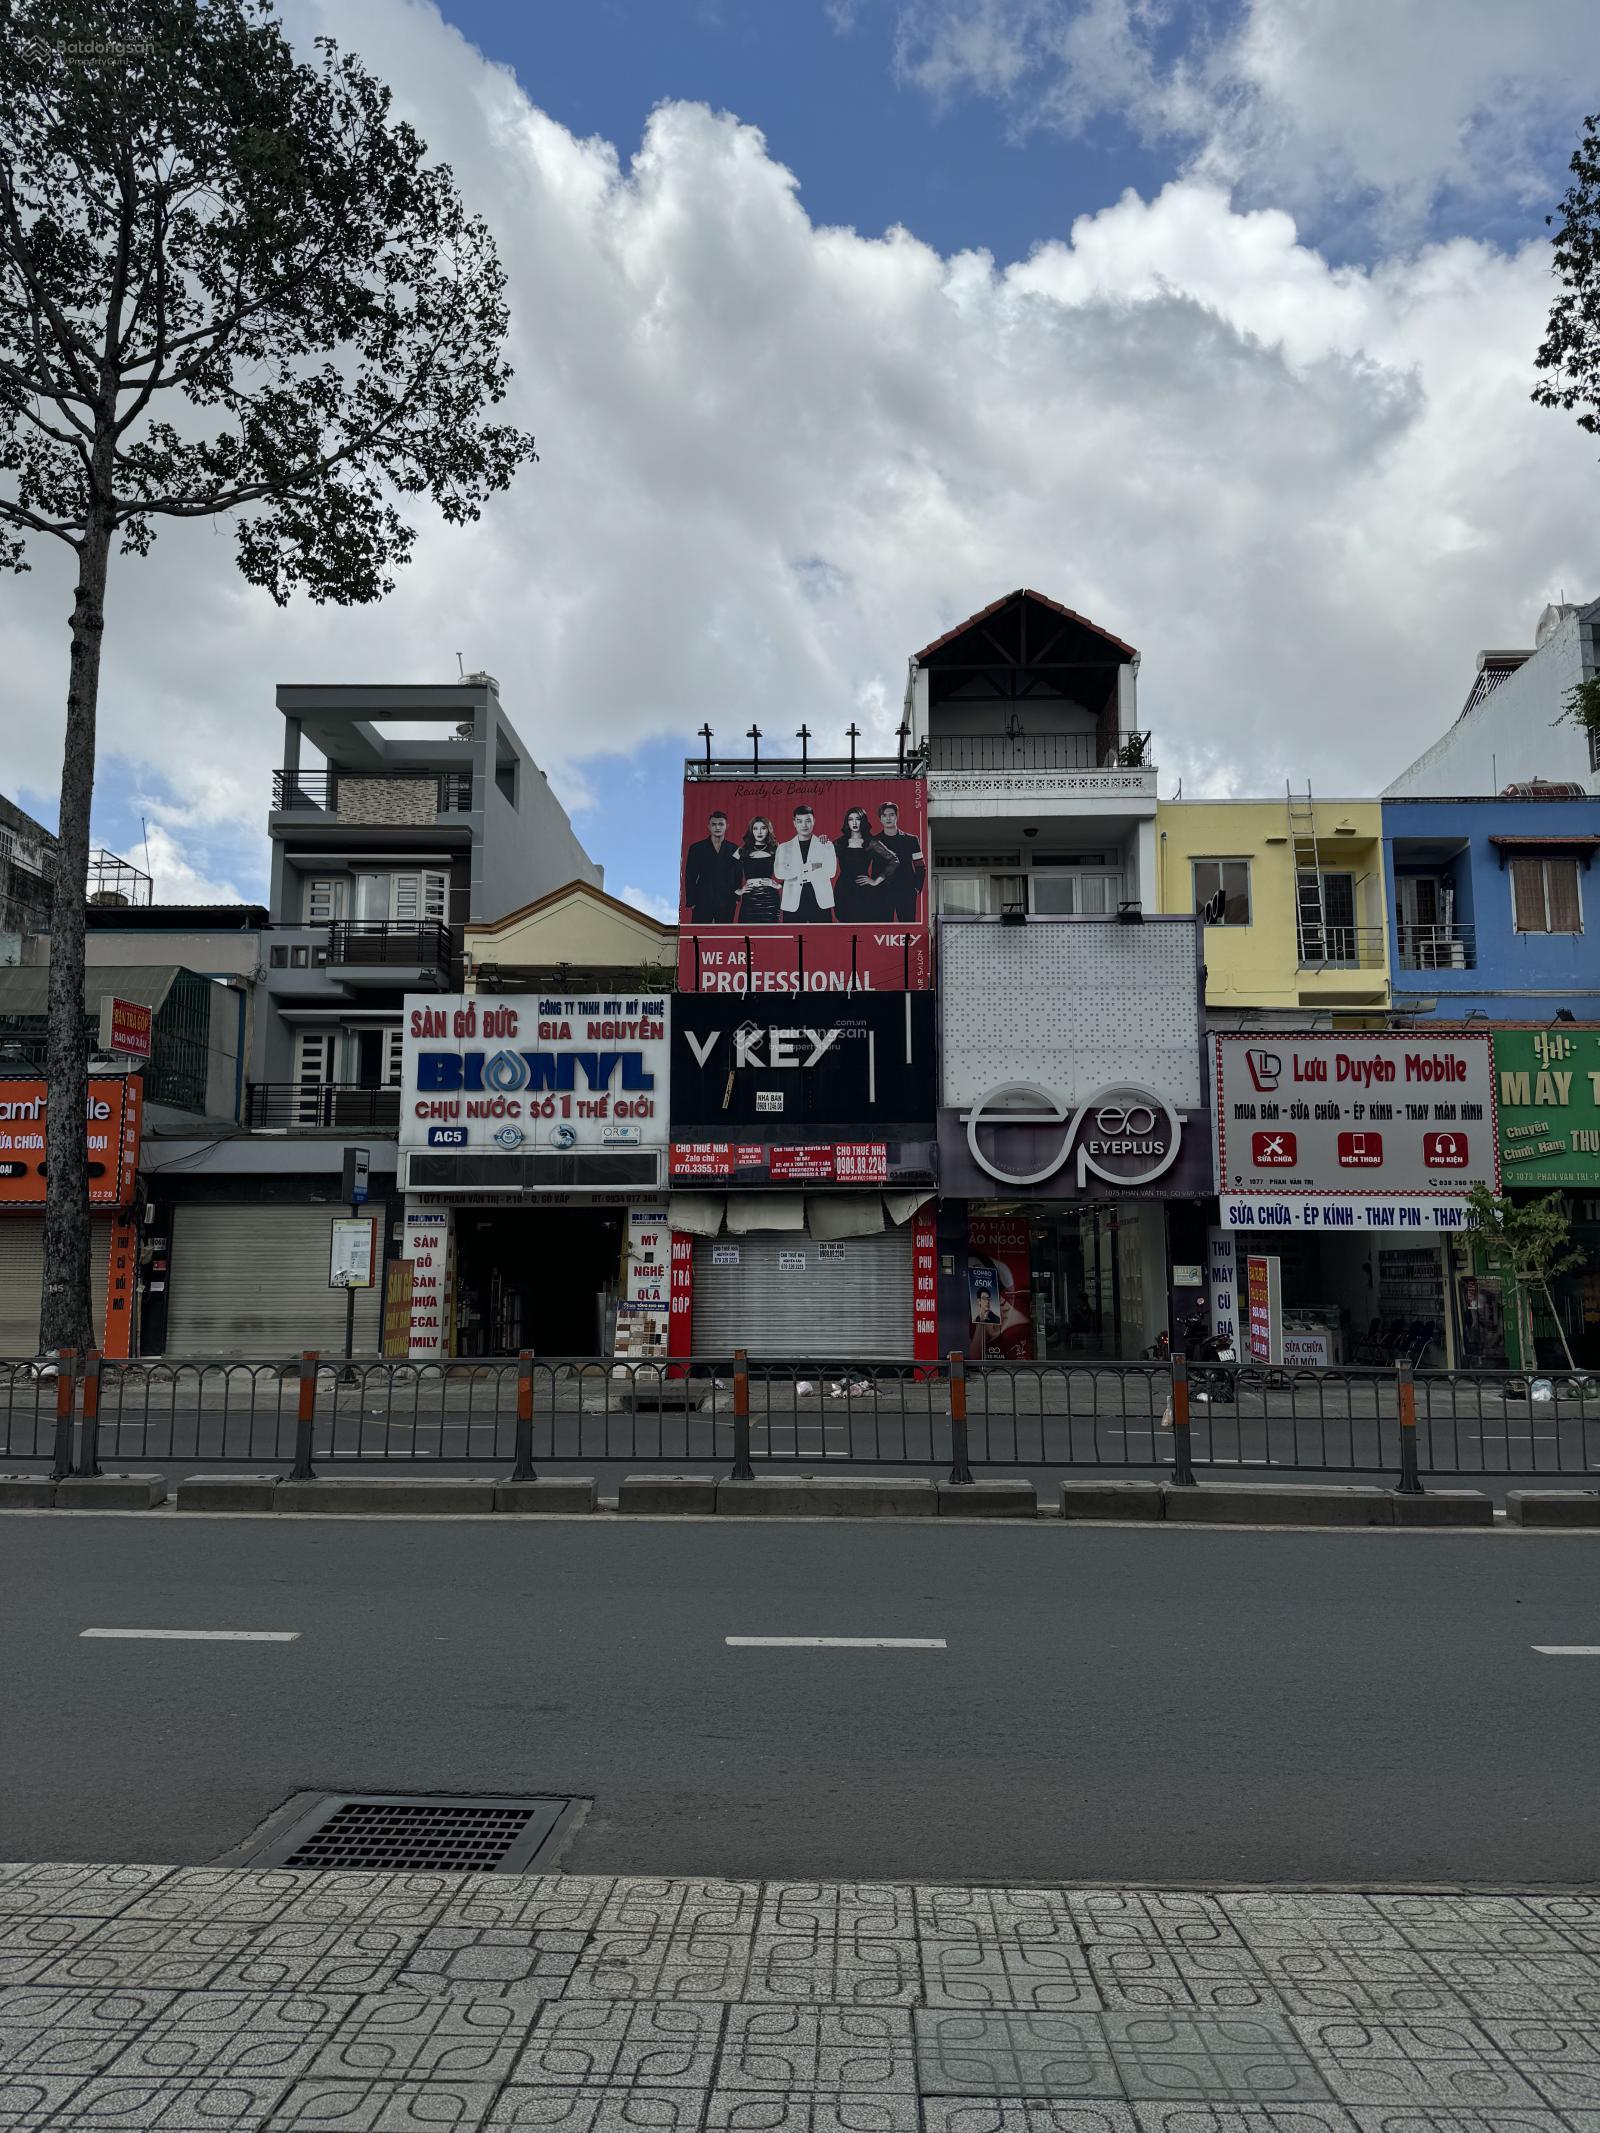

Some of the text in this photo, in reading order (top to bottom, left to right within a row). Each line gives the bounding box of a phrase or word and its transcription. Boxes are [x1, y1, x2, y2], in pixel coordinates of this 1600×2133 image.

[770, 784, 783, 796] to
[701, 951, 723, 965] WE
[701, 970, 876, 992] PROFESSIONAL
[538, 998, 665, 1018] CÔNG TY TNHH MTV MỸ NGHỆ
[410, 1001, 518, 1039] SÀN GỖ ĐỨC
[114, 1030, 126, 1044] BAO
[538, 1021, 572, 1040] GIA
[1293, 1053, 1467, 1088] Lưu Duyên Mobile
[1500, 1062, 1573, 1106] MÁY
[414, 1092, 655, 1122] CHỊU NƯỚC SỐ 1 THẾ GIỚI
[1234, 1098, 1483, 1121] MUA BÁN SỬA CHỮA ÉP KÍNH THAY MÀN HÌNH
[14, 1132, 44, 1149] CHỮA
[433, 1130, 462, 1143] AC5
[675, 1143, 728, 1154] CHO THUÊ NHÀ
[836, 1143, 886, 1156] CHO THUÊ NHÀ
[1089, 1140, 1165, 1155] EYEPLUS
[684, 1154, 700, 1162] Zalo
[836, 1156, 887, 1174] 0909.89.2248
[674, 1163, 729, 1174] 070.3355.178
[1229, 1200, 1254, 1226] SỬA
[1258, 1202, 1292, 1226] CHỮA
[1303, 1201, 1319, 1226] ÉP
[1323, 1202, 1353, 1226] KÍNH
[1365, 1207, 1394, 1226] THAY
[1399, 1208, 1421, 1226] PIN
[1432, 1207, 1462, 1226] THAY
[413, 1234, 439, 1249] SÀN
[641, 1233, 659, 1246] MỸ
[988, 1233, 1025, 1247] NGỌC
[1212, 1241, 1231, 1256] THU
[672, 1239, 691, 1260] MÁY
[416, 1252, 433, 1268] GỖ
[918, 1255, 933, 1273] PHỤ
[633, 1263, 665, 1280] NGHỆ
[672, 1265, 690, 1287] TRẢ
[1212, 1264, 1233, 1283] MÁY
[412, 1274, 437, 1288] SÀN
[918, 1275, 934, 1293] KIỆN
[672, 1293, 690, 1314] GÓP
[915, 1294, 936, 1312] CHÍNH
[1217, 1291, 1231, 1310] CŨ
[410, 1316, 439, 1328] ECAL
[1217, 1317, 1234, 1336] GIÁ
